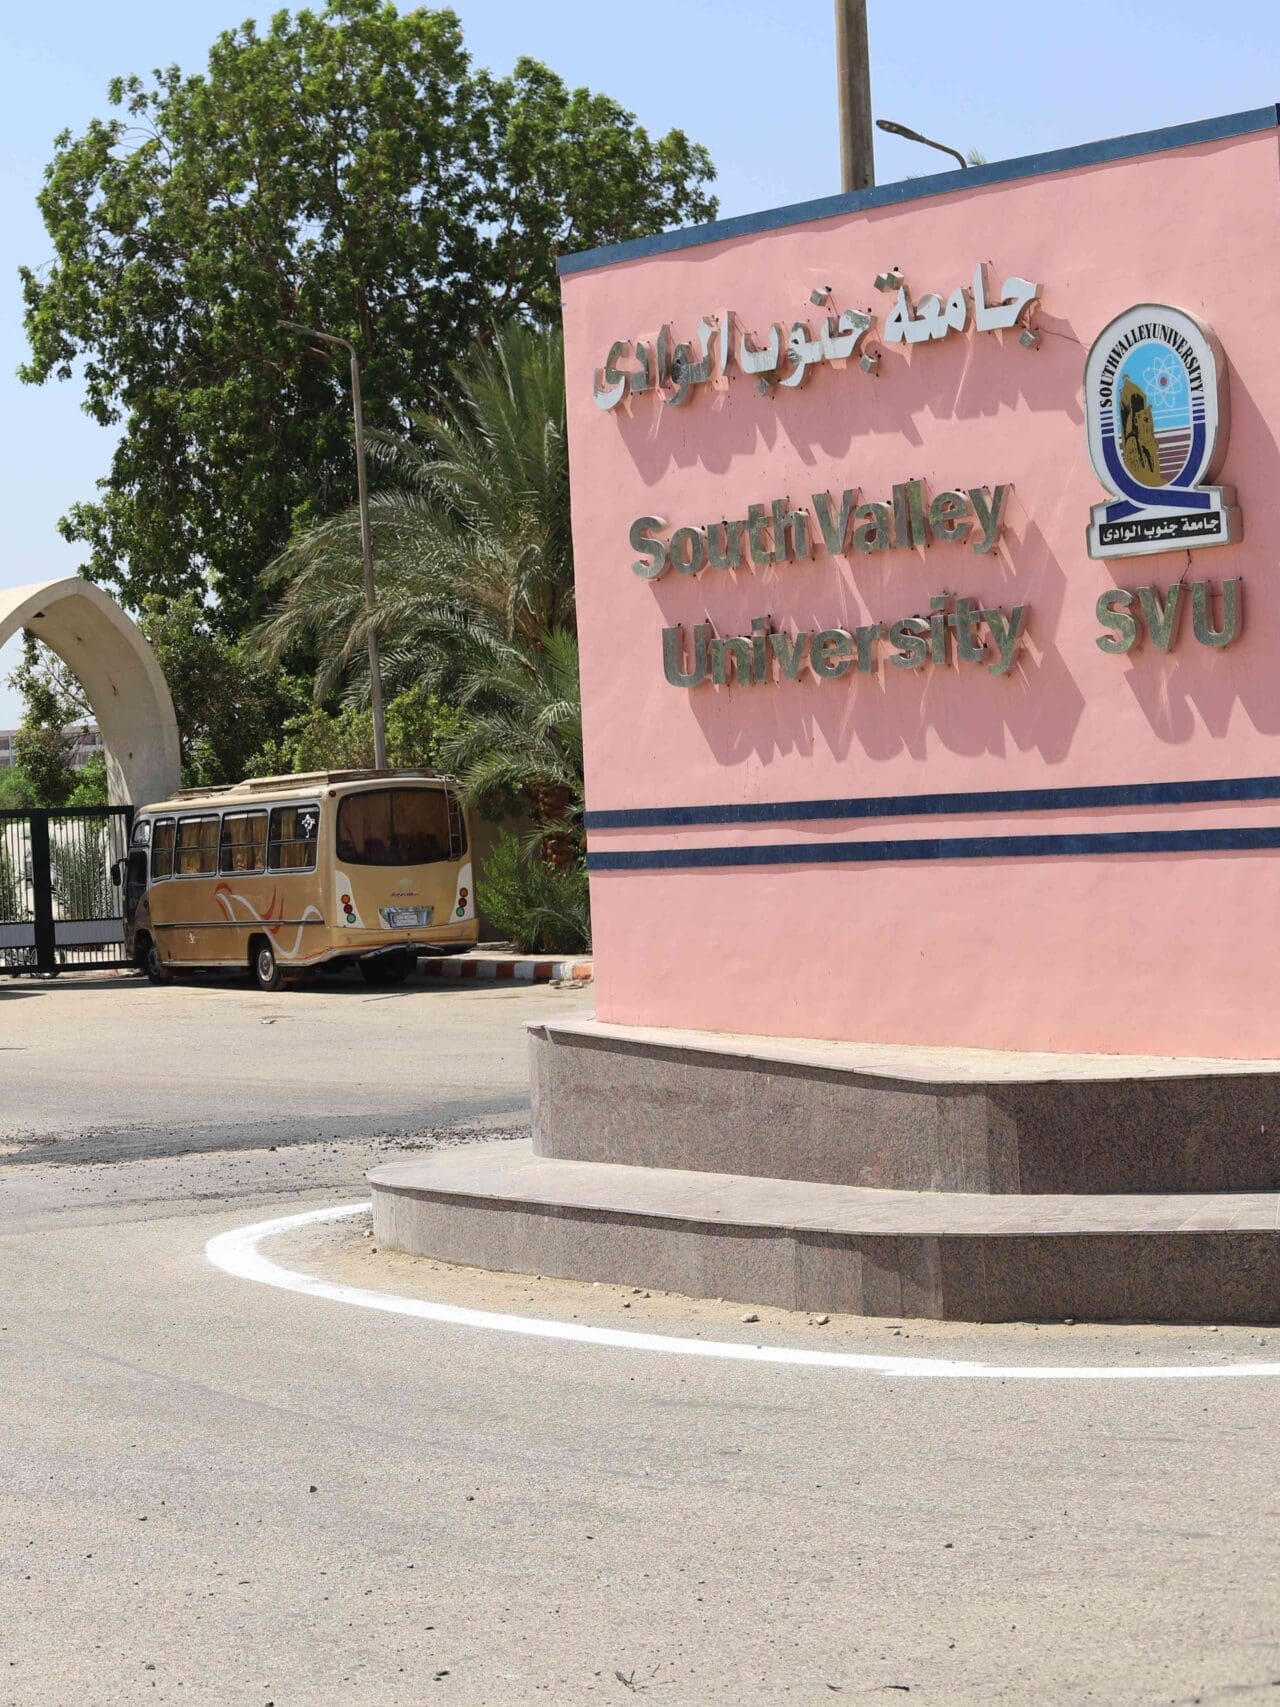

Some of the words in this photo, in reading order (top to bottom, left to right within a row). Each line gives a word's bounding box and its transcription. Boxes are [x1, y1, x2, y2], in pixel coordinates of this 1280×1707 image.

[740, 286, 877, 398] جنوب
[874, 263, 1043, 349] جامعة
[629, 497, 812, 580] South
[811, 478, 1014, 556] Valley
[1144, 520, 1178, 540] جنوب
[1181, 516, 1220, 532] جامعة
[662, 594, 1028, 689] University
[1096, 579, 1241, 655] SVU
